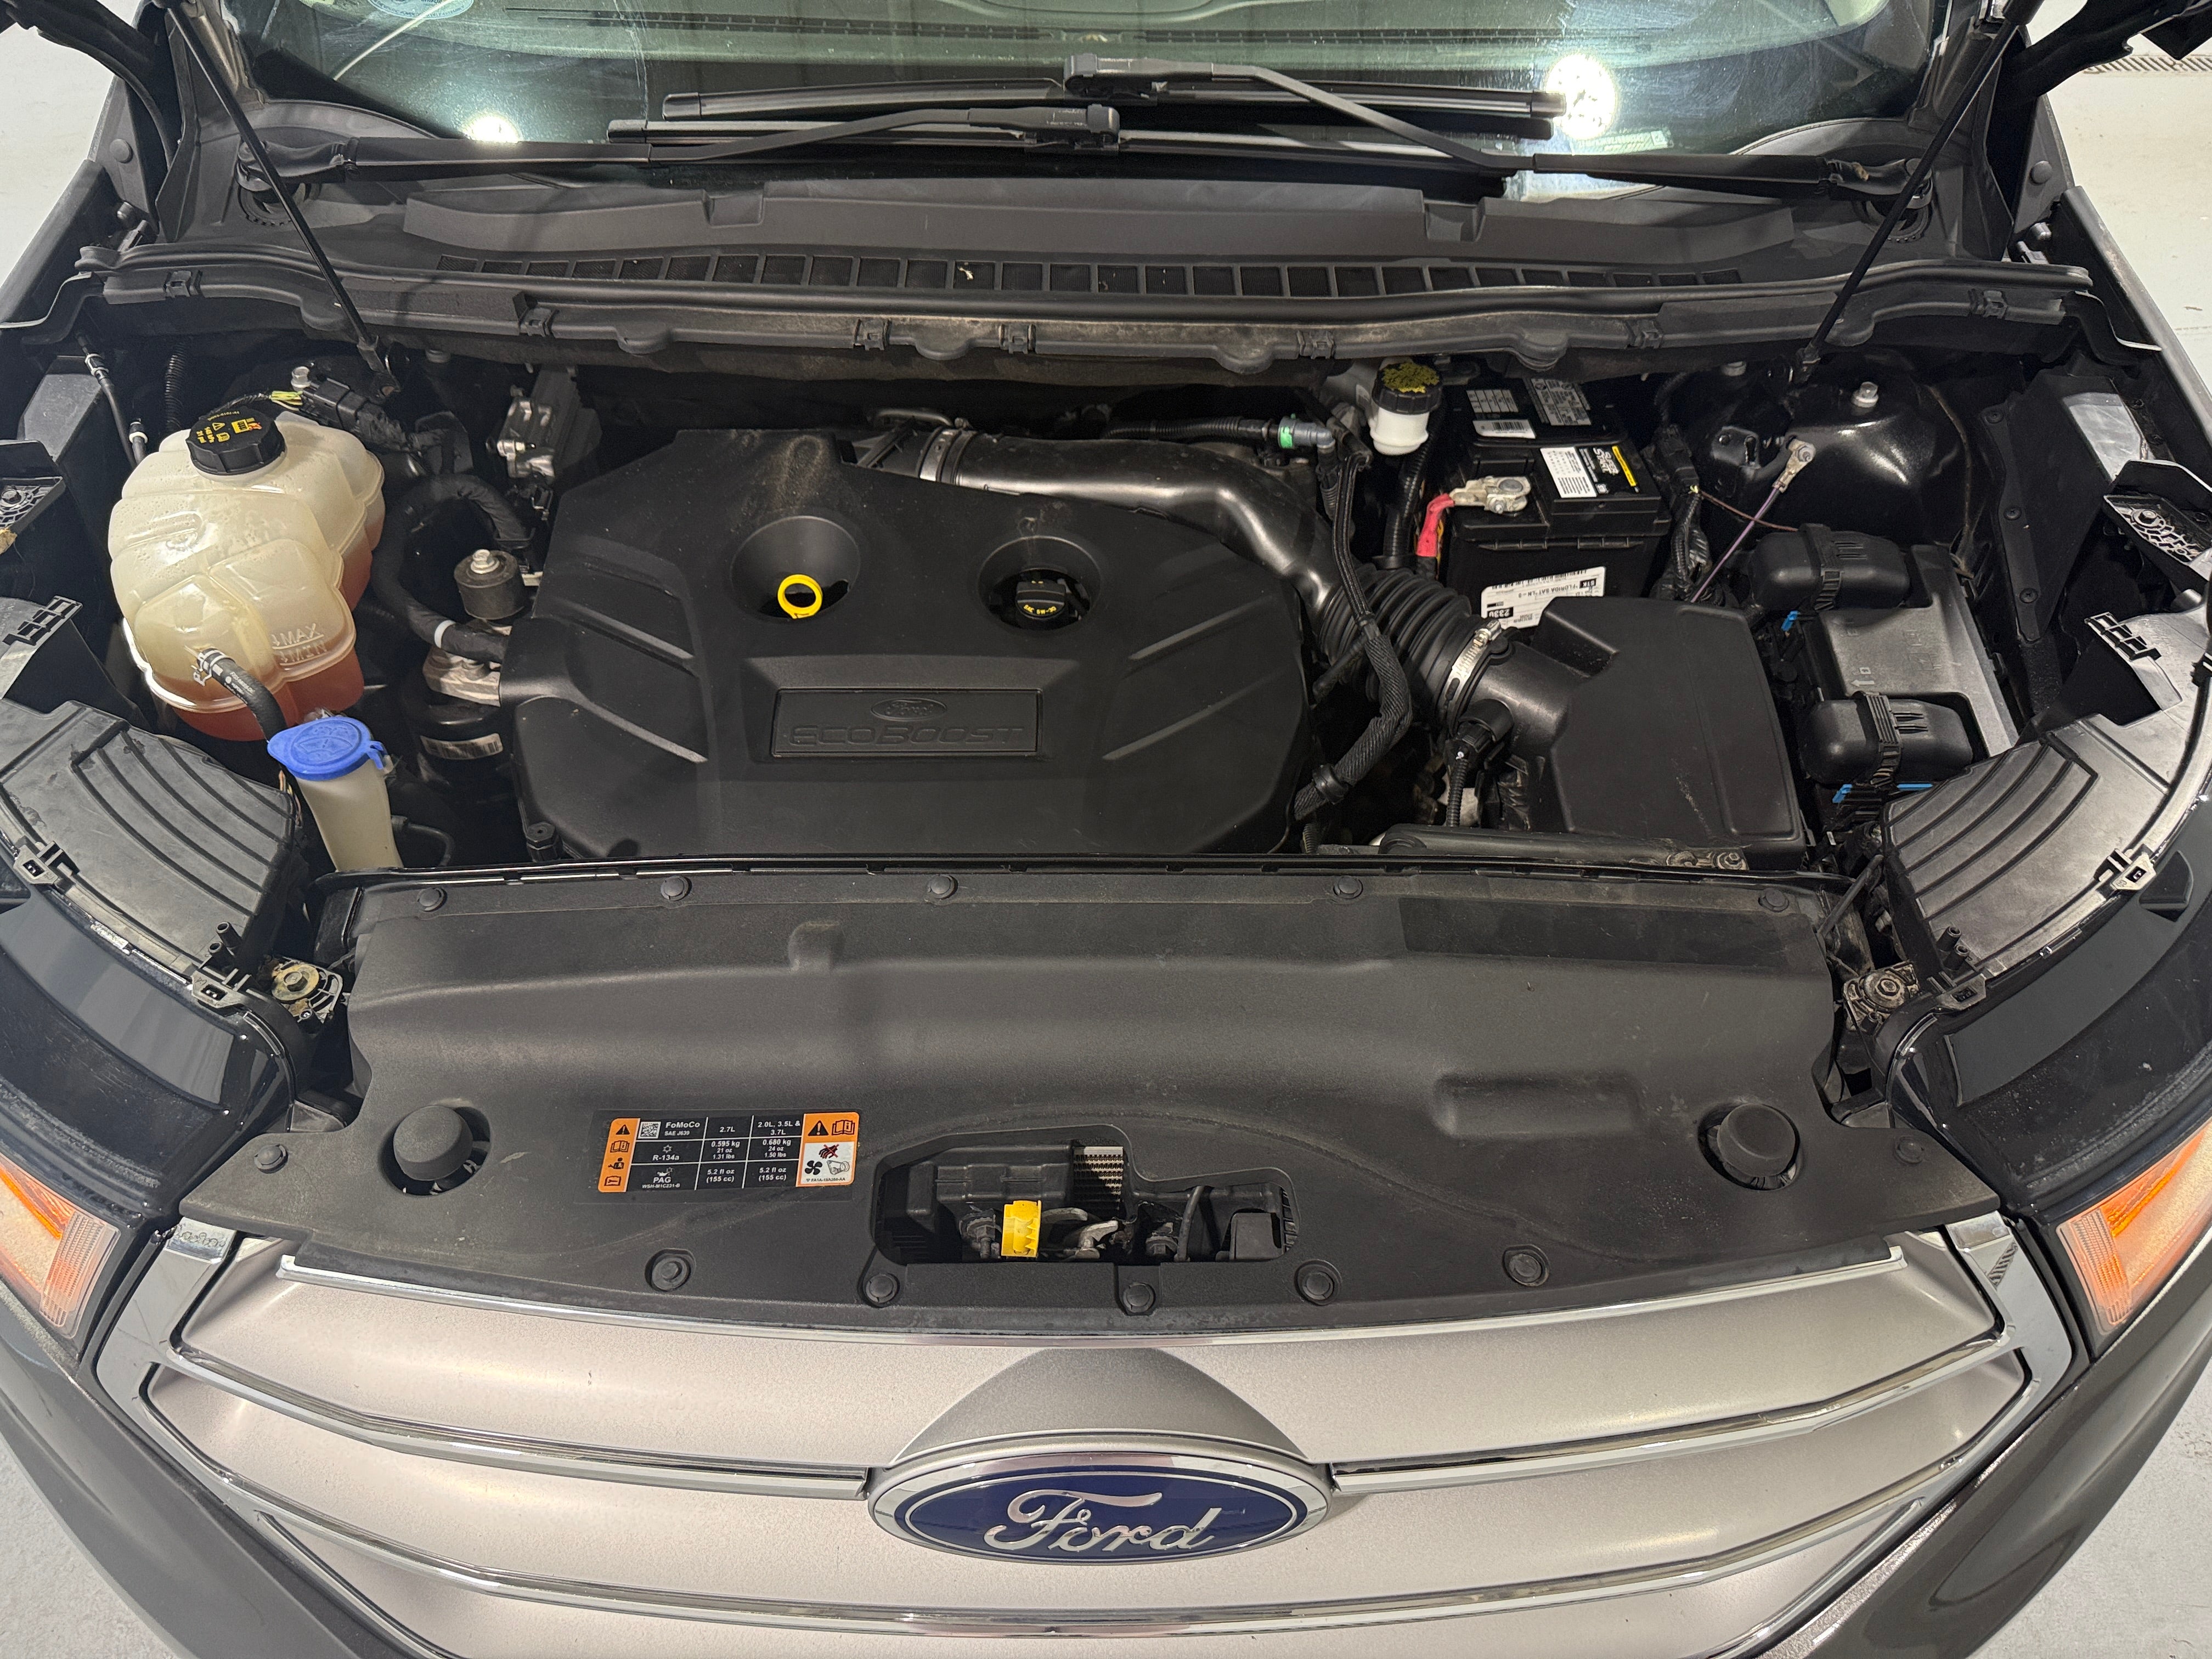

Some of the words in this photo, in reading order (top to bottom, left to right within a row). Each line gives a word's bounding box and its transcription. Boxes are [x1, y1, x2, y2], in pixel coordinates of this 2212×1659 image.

[280, 623, 321, 646] MAX
[289, 640, 327, 662] MIN
[984, 1489, 1222, 1553] Ford
